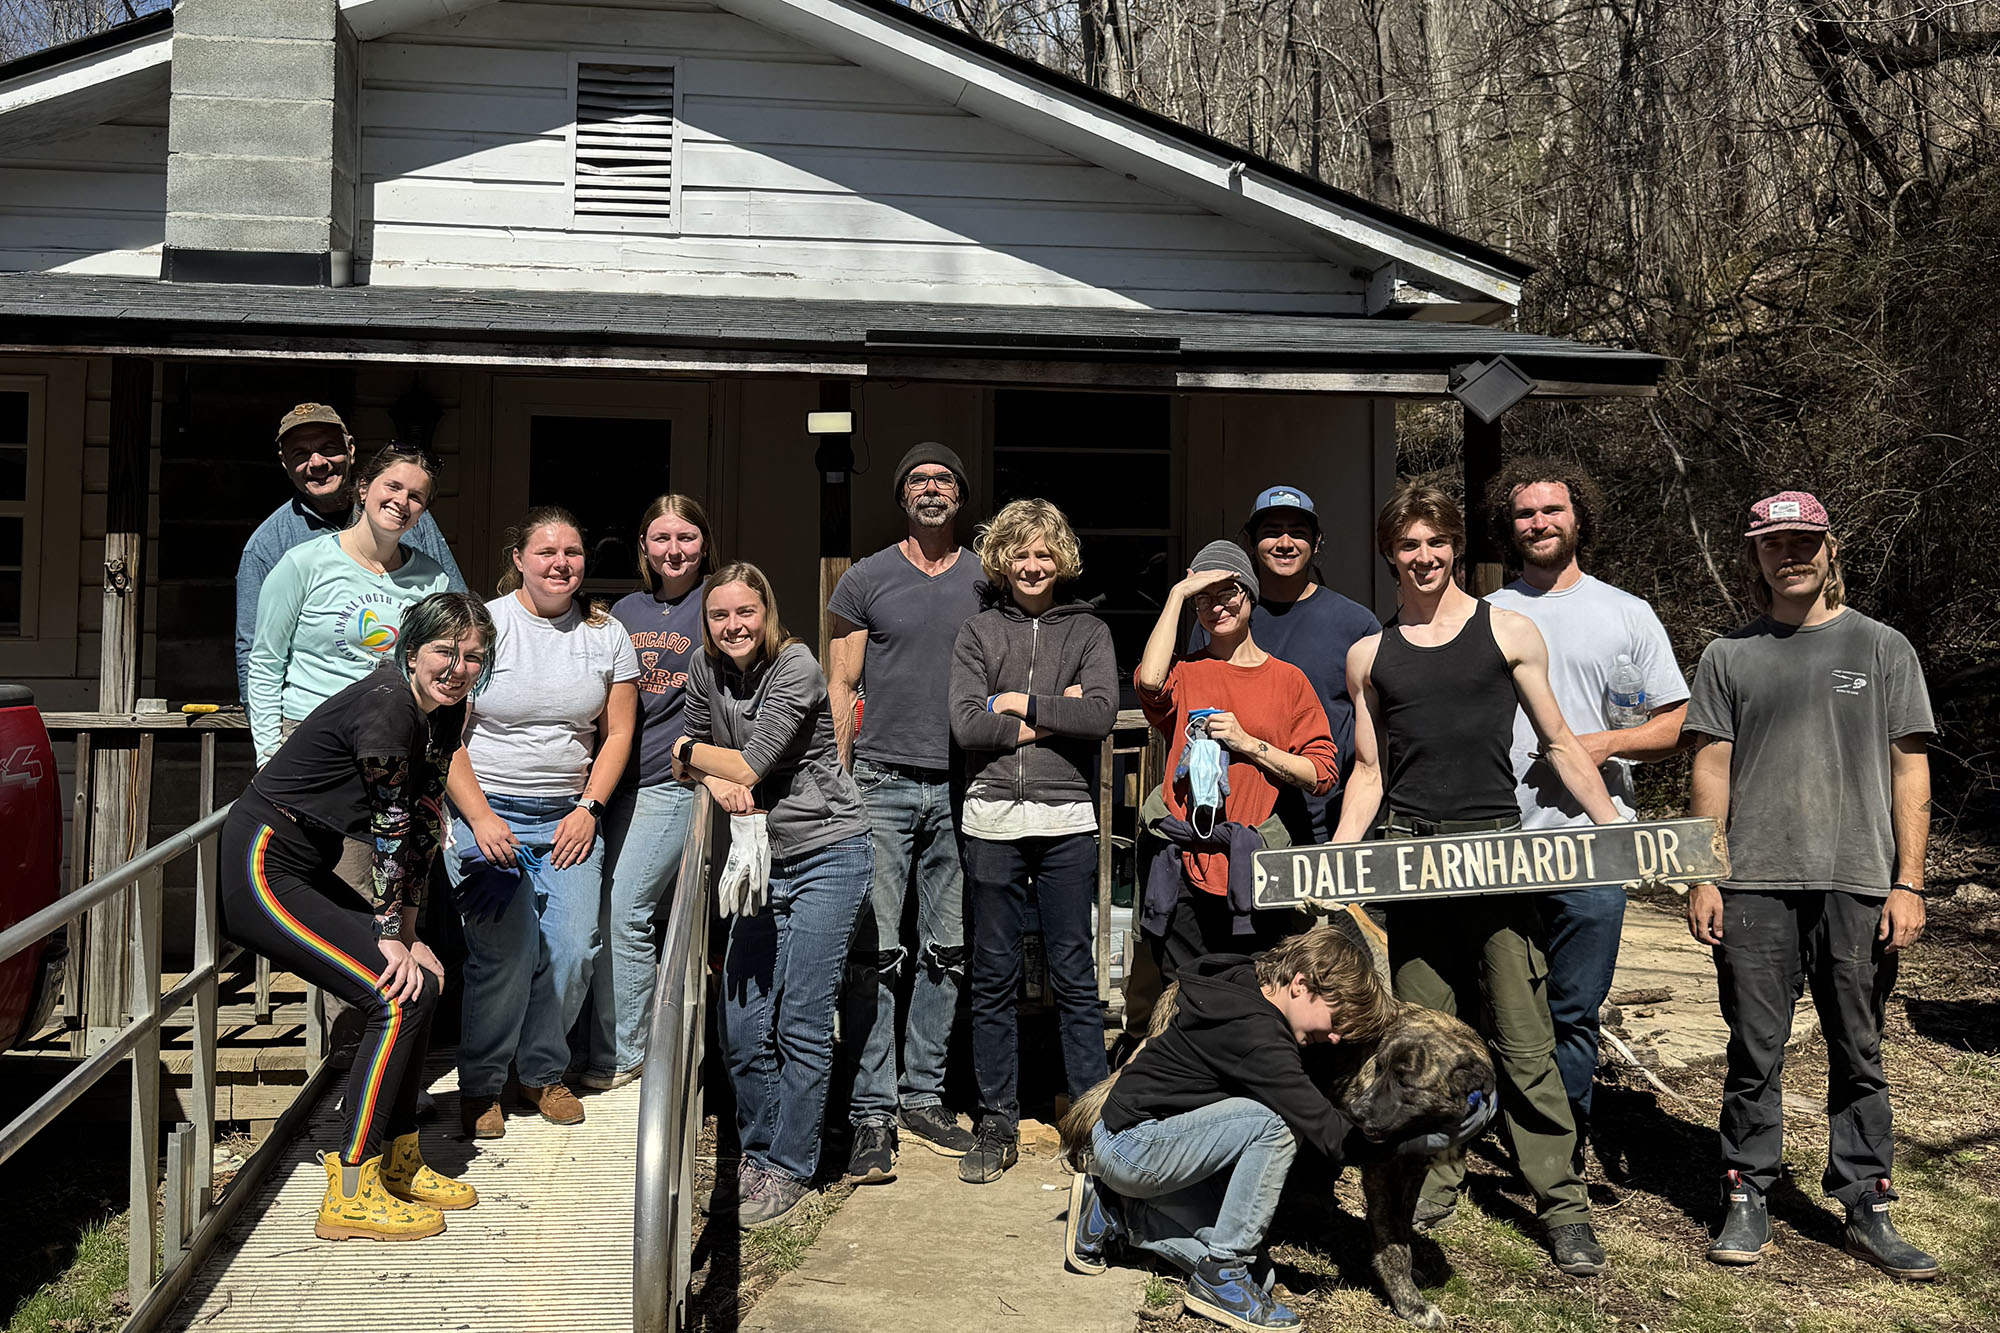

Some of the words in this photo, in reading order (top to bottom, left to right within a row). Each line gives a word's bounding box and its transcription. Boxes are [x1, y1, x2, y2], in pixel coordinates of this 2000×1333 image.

[358, 592, 392, 605] YOUTH
[630, 631, 691, 655] HICAGO
[1292, 849, 1376, 898] DALE
[1397, 833, 1596, 892] EARNHARDT
[1634, 828, 1695, 876] DR.
